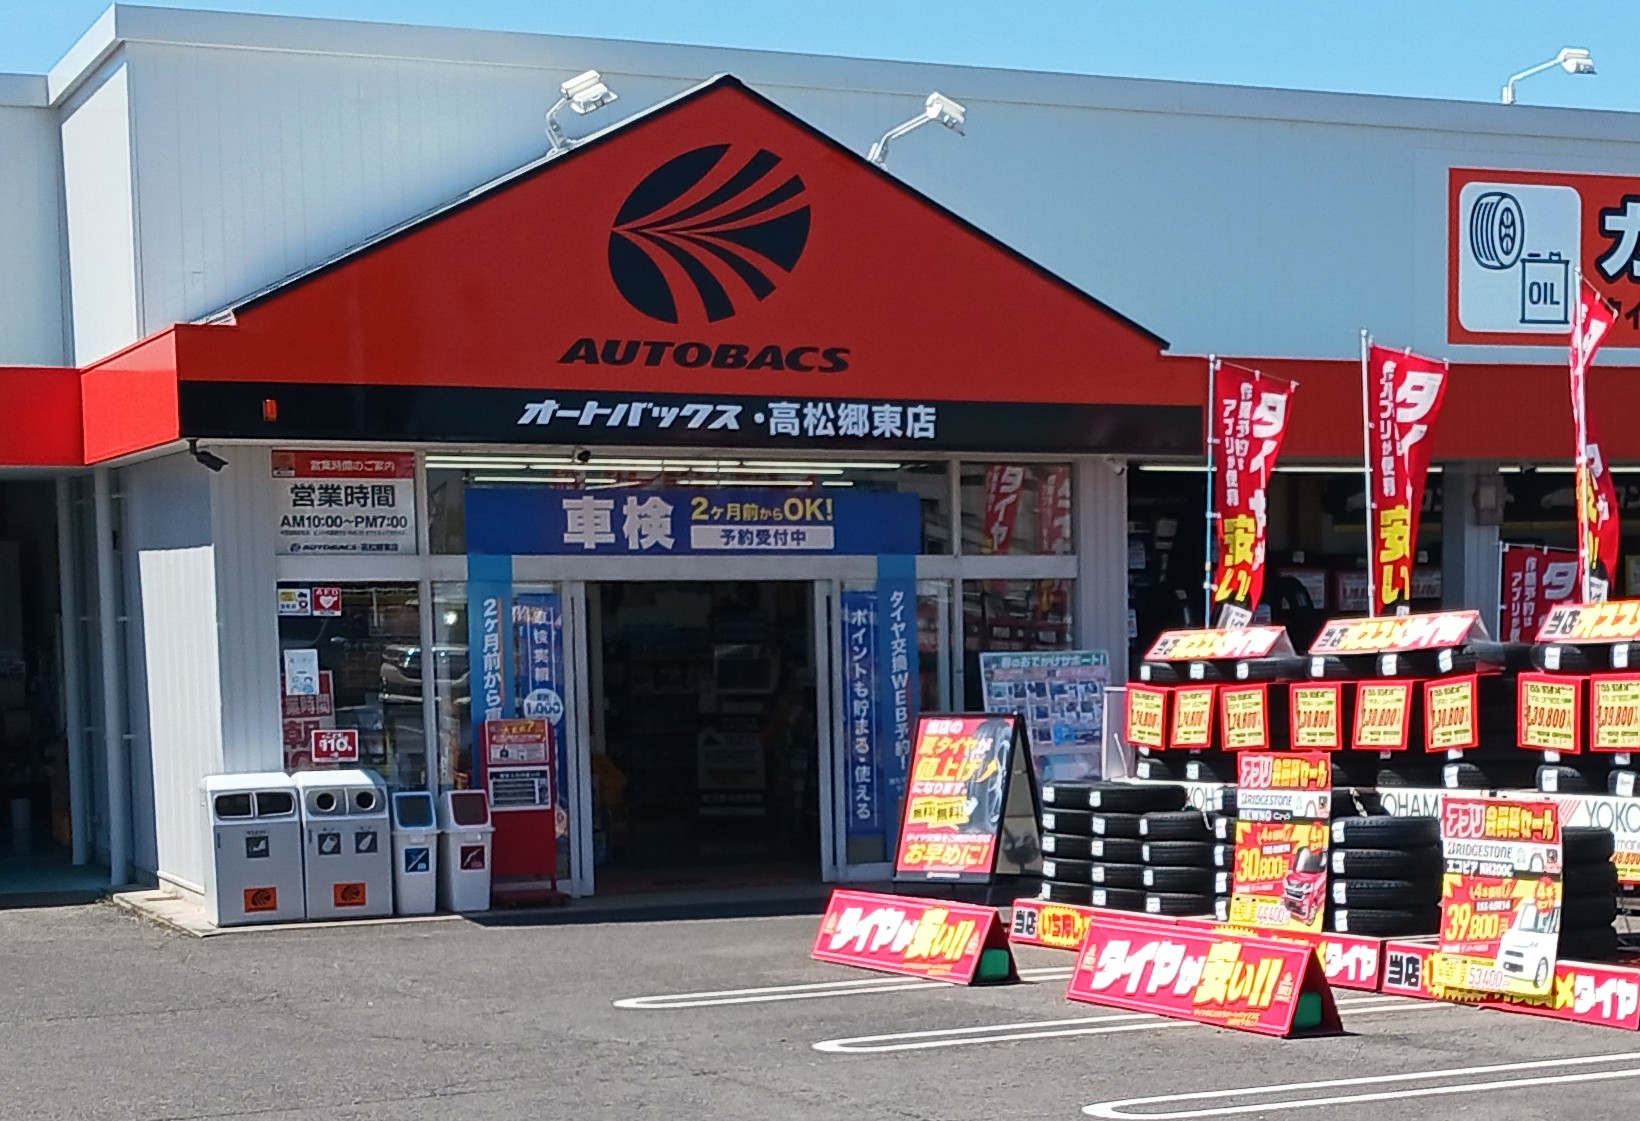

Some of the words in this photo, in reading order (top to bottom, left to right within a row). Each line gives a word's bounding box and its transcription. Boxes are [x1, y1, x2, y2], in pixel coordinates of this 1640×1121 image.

[1529, 282, 1560, 305] OIL
[557, 338, 850, 373] AUTOBACS
[517, 400, 937, 439] オートバックス・高松郷東店
[290, 484, 396, 508] 営業時間
[562, 496, 676, 549] 車検
[719, 529, 807, 546] 予約受付中
[1446, 903, 1500, 942] 39,800
[1091, 939, 1285, 1008] タイヤが安い!!
